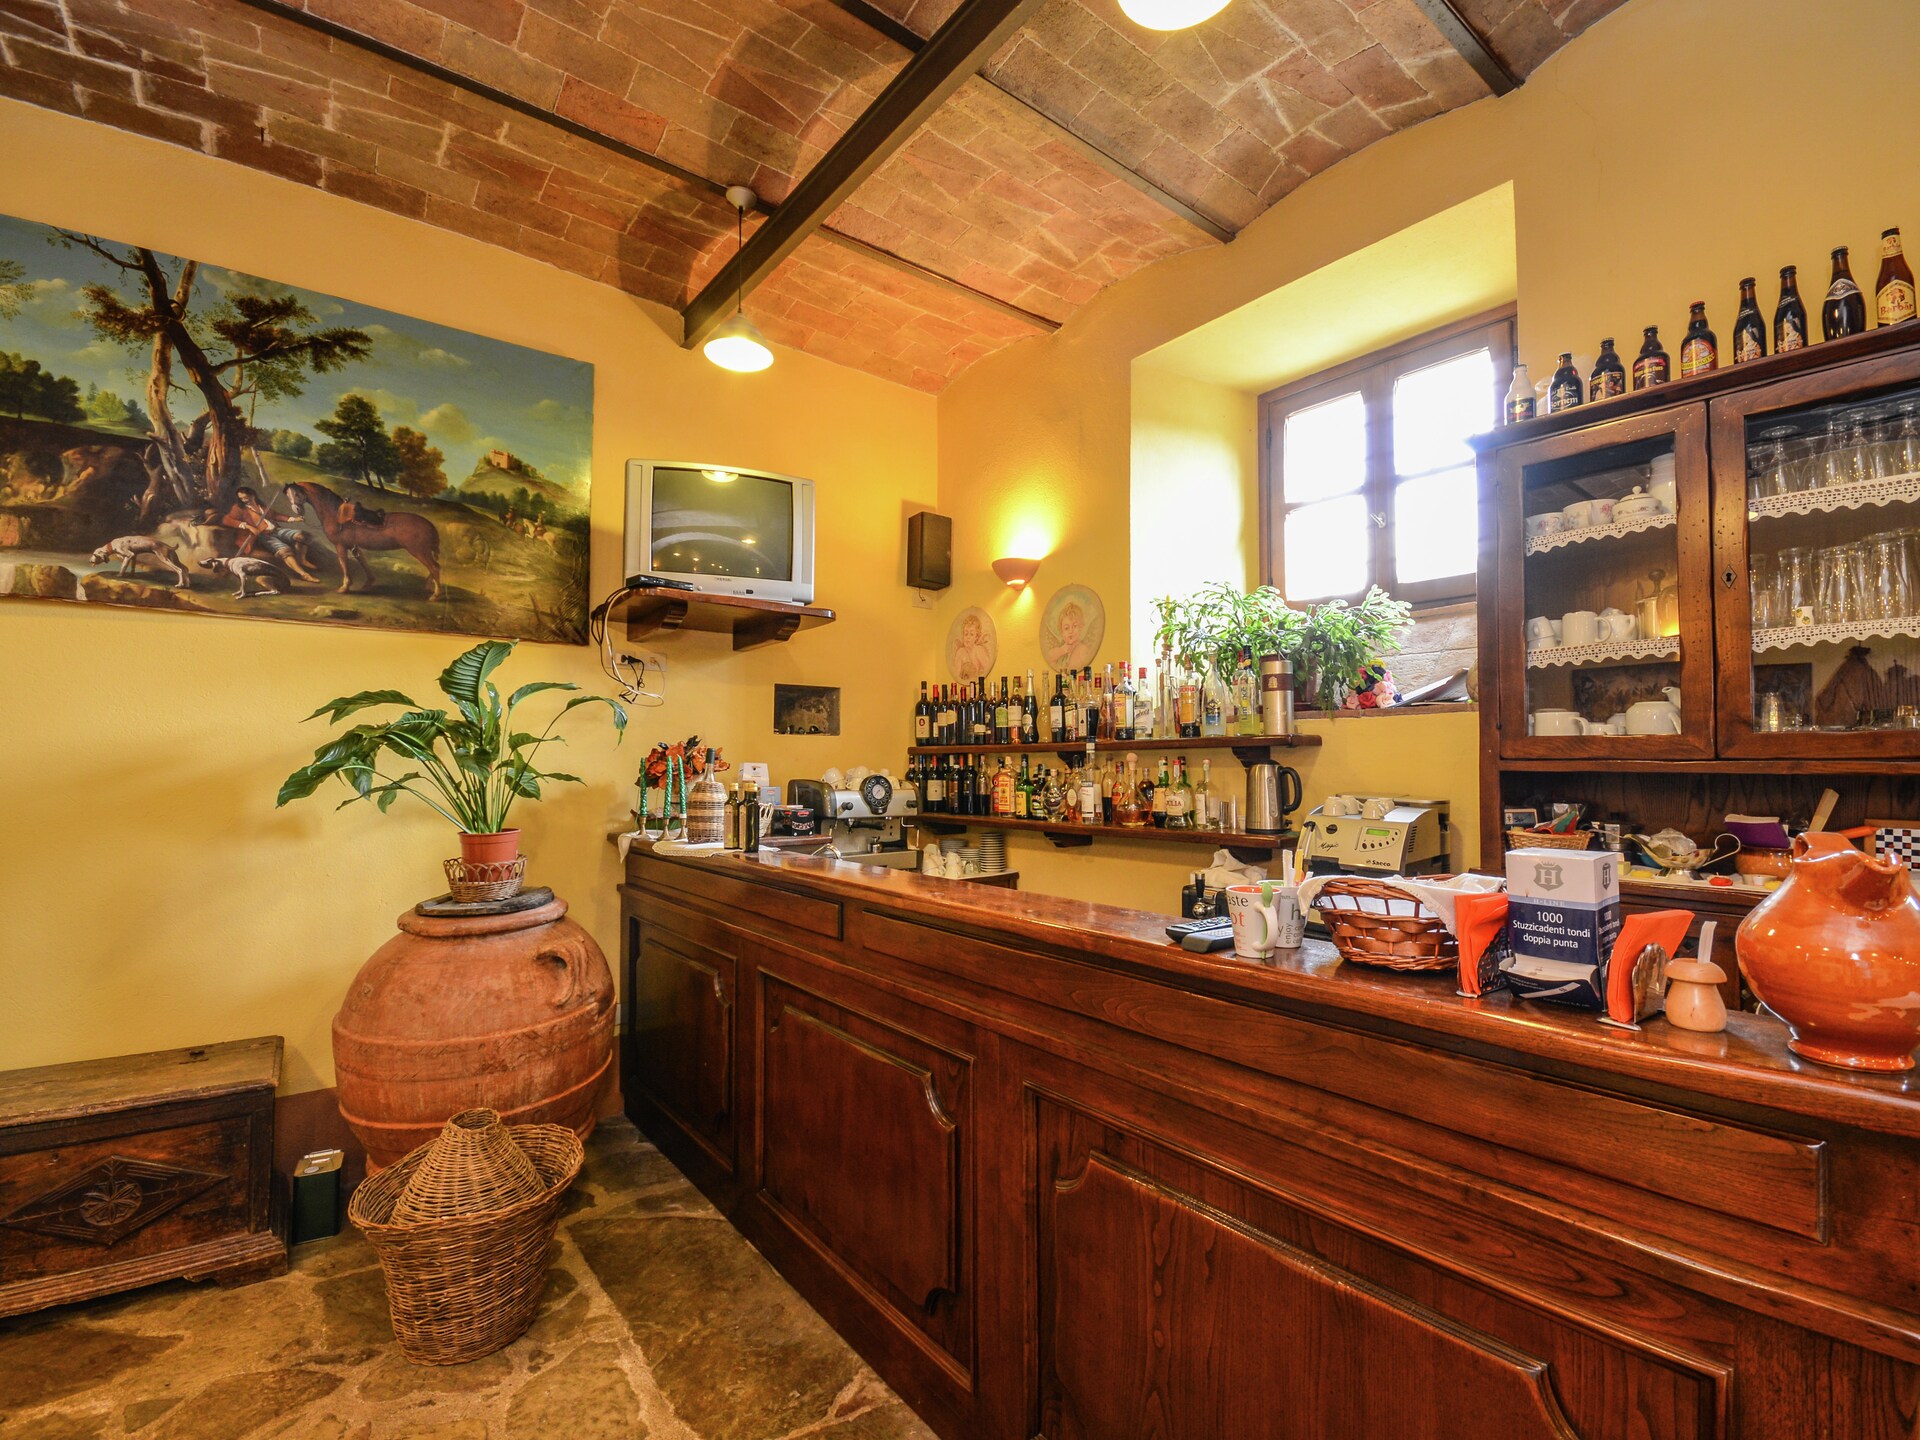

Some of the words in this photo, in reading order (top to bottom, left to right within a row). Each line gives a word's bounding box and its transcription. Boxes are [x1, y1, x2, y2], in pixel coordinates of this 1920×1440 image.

[1372, 859, 1391, 867] Saeco
[1539, 869, 1559, 886] H
[1536, 911, 1564, 924] 1000
[1512, 919, 1565, 936] Stuzzicadenti
[1567, 927, 1592, 939] tondi
[1523, 933, 1552, 947] doppia
[1553, 938, 1579, 949] punta
